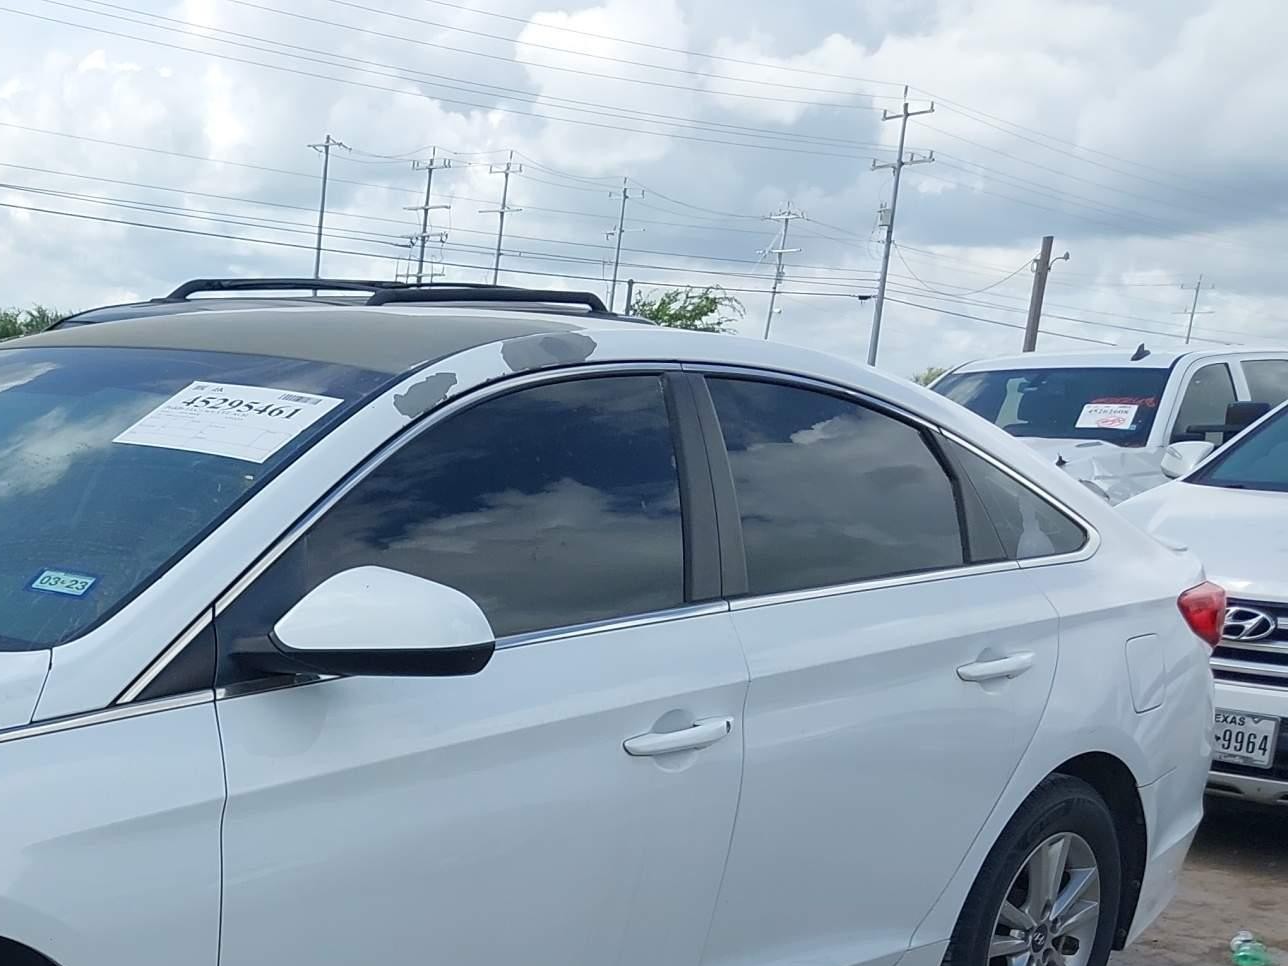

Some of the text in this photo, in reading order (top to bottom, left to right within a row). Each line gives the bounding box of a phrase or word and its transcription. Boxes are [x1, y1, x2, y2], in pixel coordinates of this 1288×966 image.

[182, 394, 303, 420] 45295461
[39, 575, 89, 590] 03 23
[1214, 713, 1246, 726] EXAS
